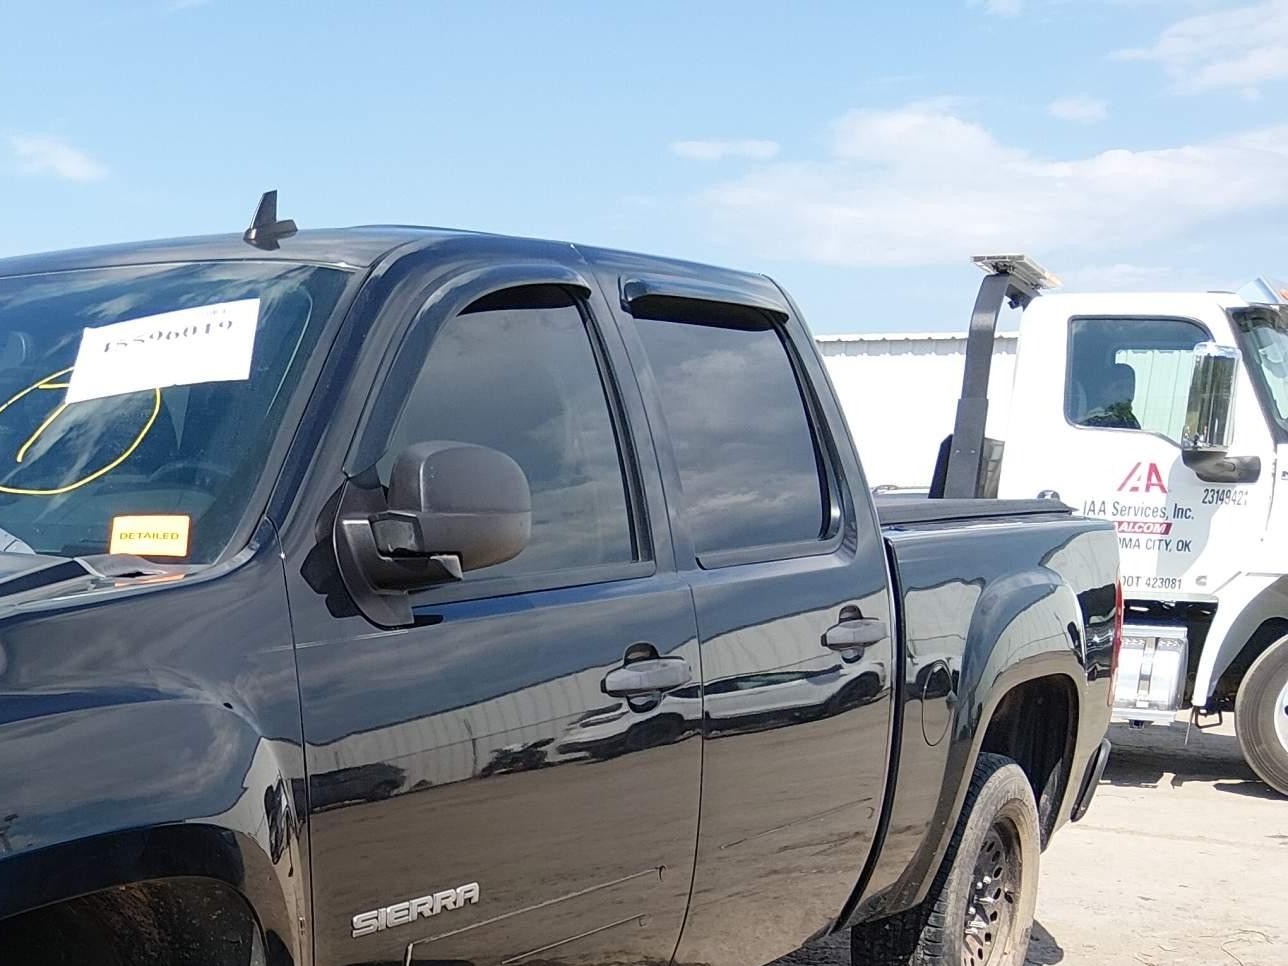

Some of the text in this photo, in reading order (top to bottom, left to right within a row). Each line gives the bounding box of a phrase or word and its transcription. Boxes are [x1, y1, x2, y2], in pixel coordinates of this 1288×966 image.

[1083, 500, 1194, 520] IAA Services, Inc.
[119, 532, 179, 540] DETAILED
[1145, 538, 1172, 552] CITY,
[1176, 539, 1192, 552] OK
[1145, 577, 1182, 590] 423081
[352, 881, 480, 938] SIERRA
